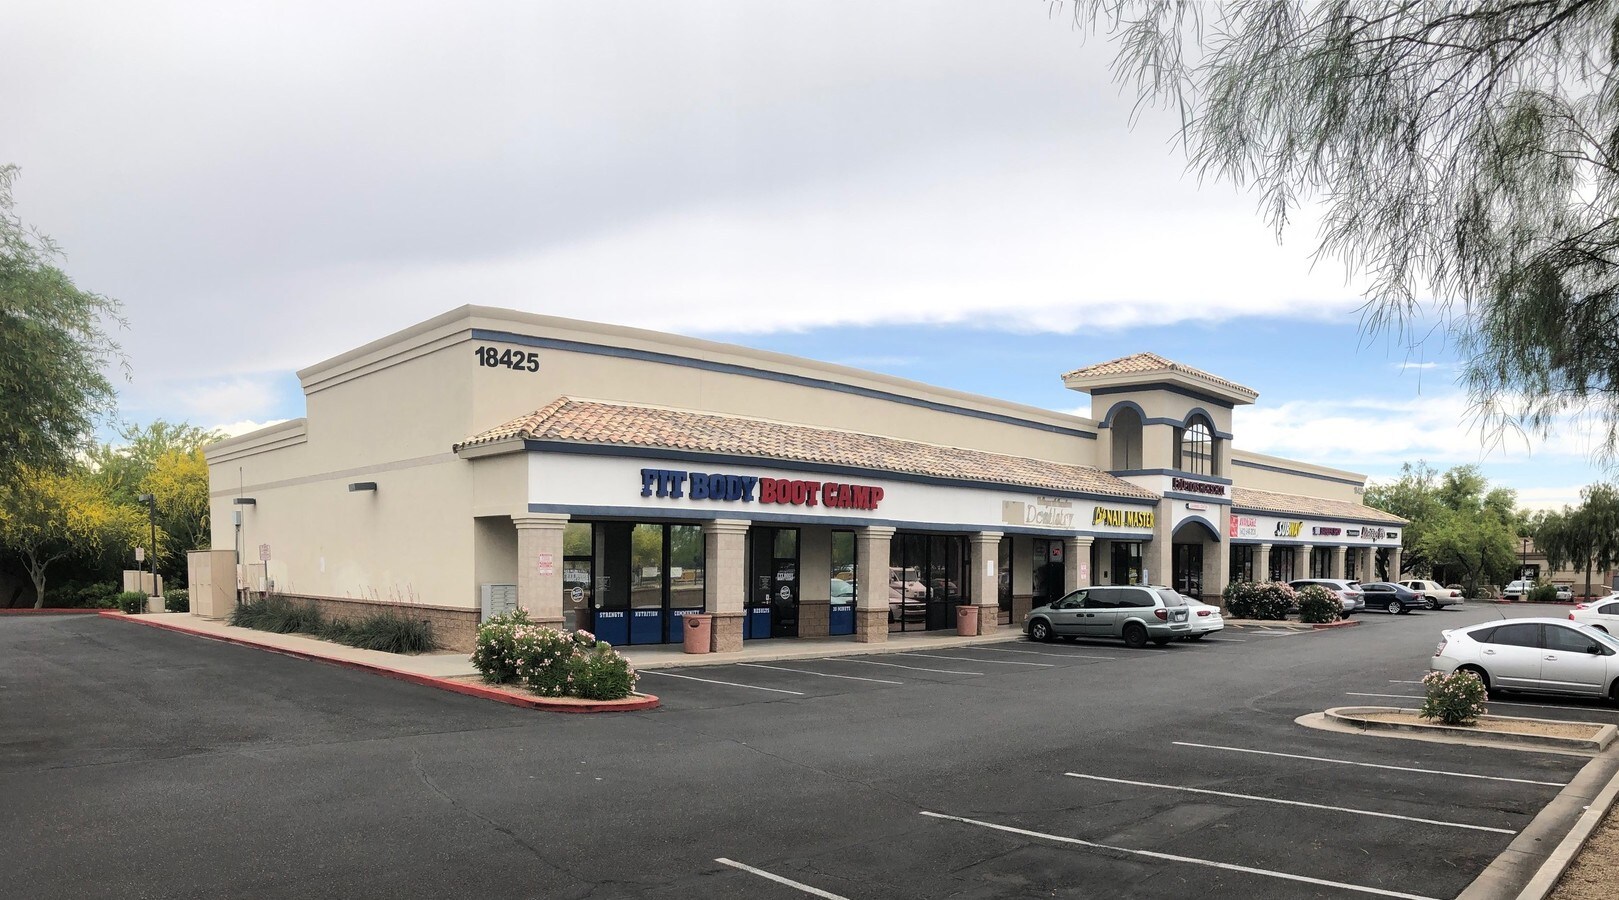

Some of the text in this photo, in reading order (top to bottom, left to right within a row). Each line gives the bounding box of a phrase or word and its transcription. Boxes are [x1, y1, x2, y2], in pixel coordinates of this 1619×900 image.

[475, 346, 540, 372] 18425
[641, 468, 884, 510] FIT BODY BOOT CAMP
[1105, 509, 1123, 527] NAIL
[1124, 511, 1155, 528] MASTER
[1274, 521, 1304, 538] SUBWAY
